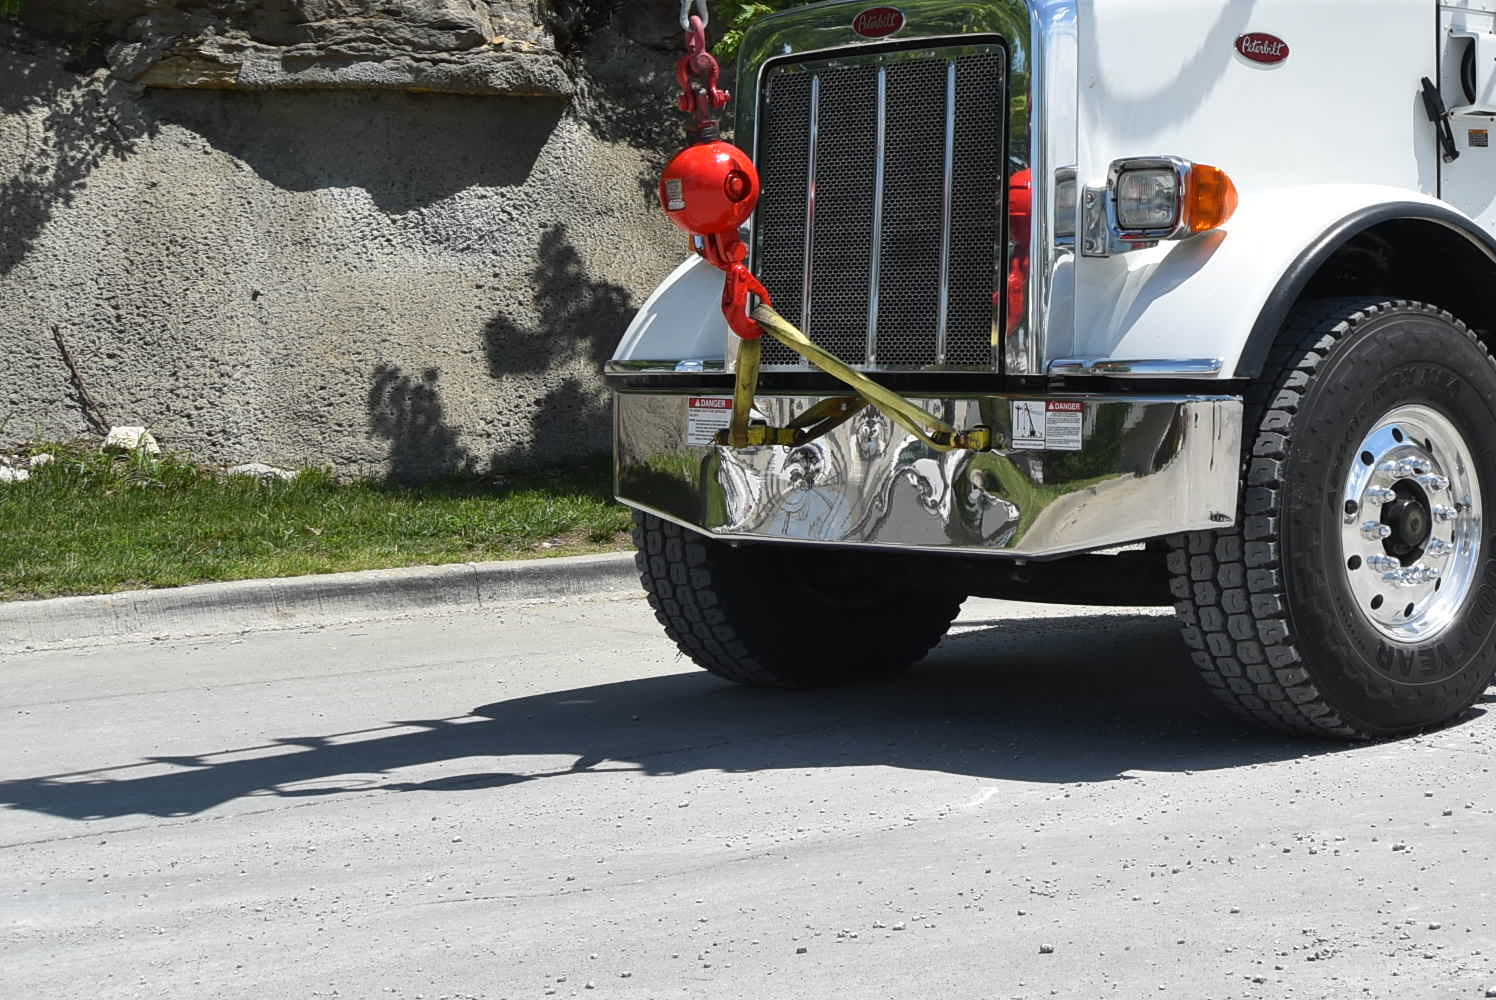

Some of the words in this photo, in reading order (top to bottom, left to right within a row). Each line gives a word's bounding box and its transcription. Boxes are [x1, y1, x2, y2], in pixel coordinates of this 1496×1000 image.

[1241, 36, 1286, 56] Peterbilt
[700, 399, 726, 408] DANGER
[1055, 402, 1081, 410] DANGER
